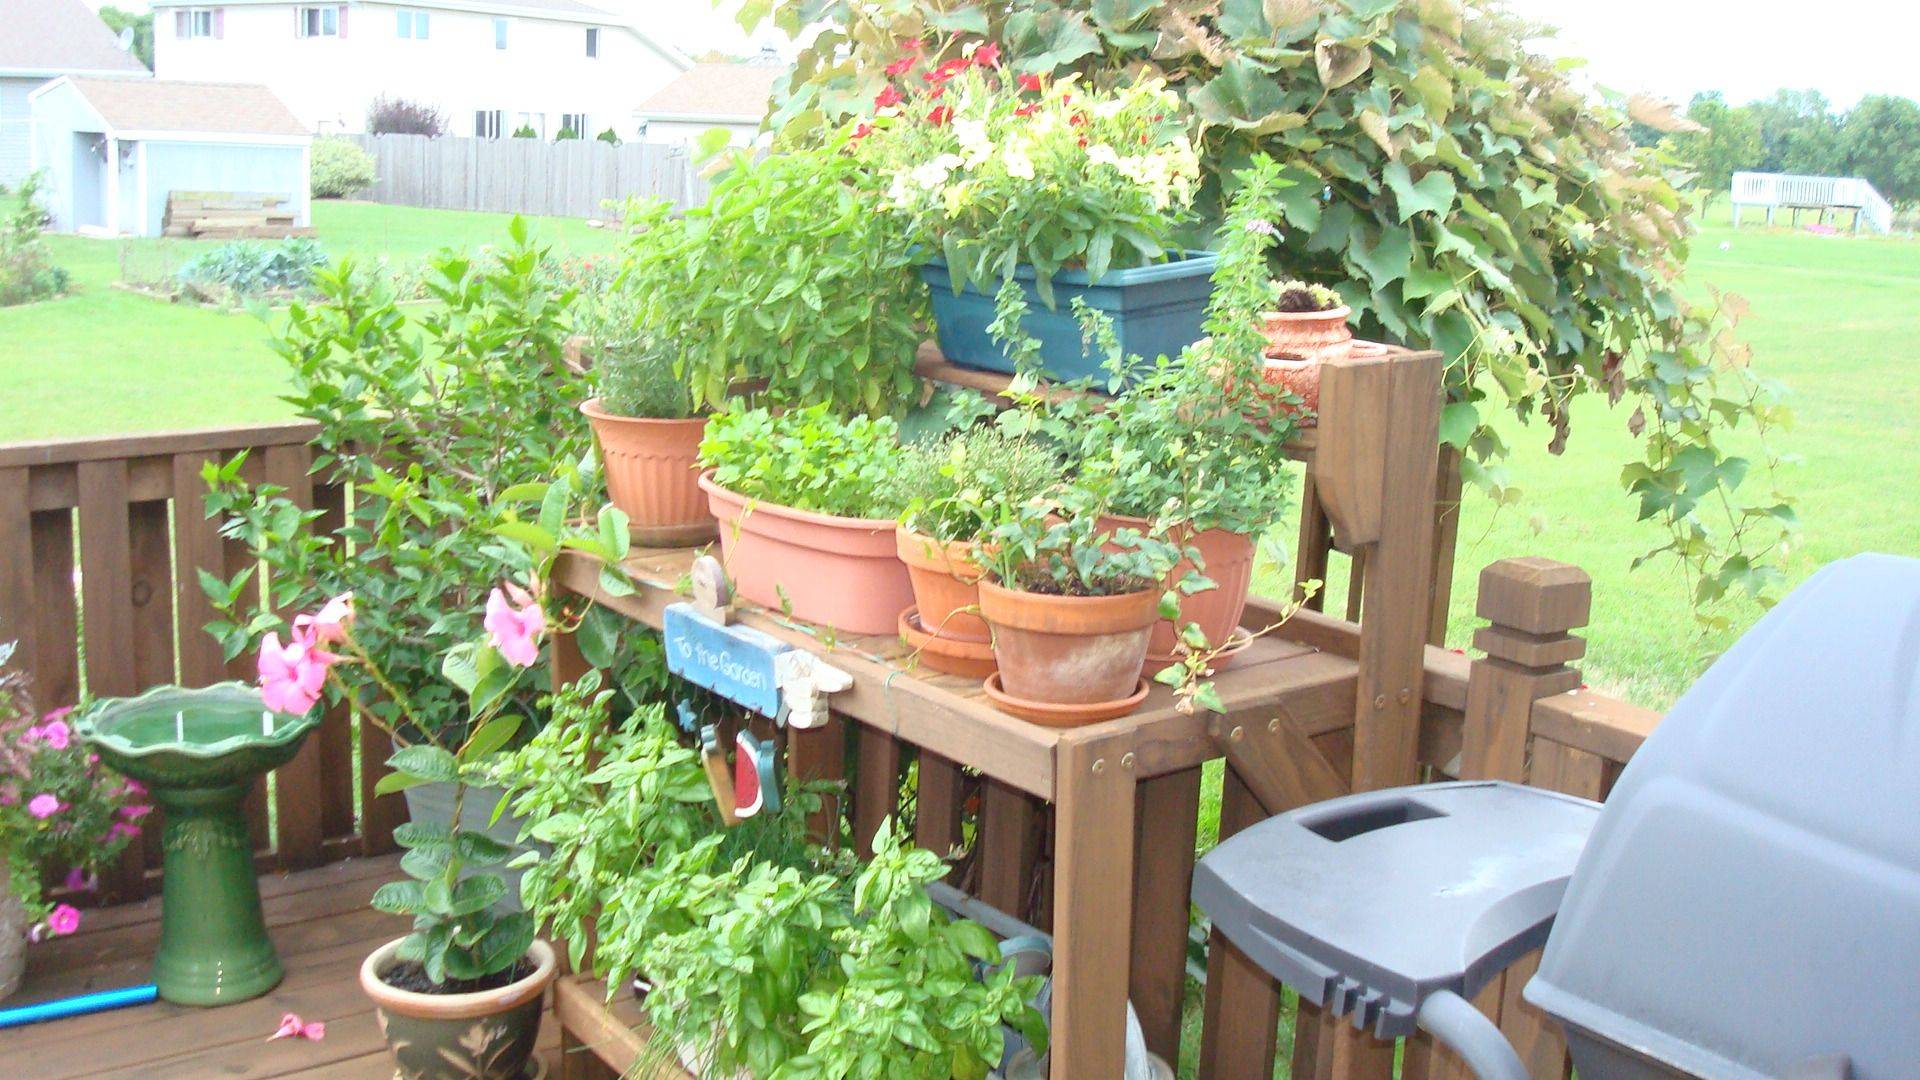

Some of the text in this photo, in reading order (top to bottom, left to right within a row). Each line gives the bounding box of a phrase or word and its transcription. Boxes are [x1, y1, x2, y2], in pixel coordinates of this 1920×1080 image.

[673, 636, 768, 691] To the Garden
